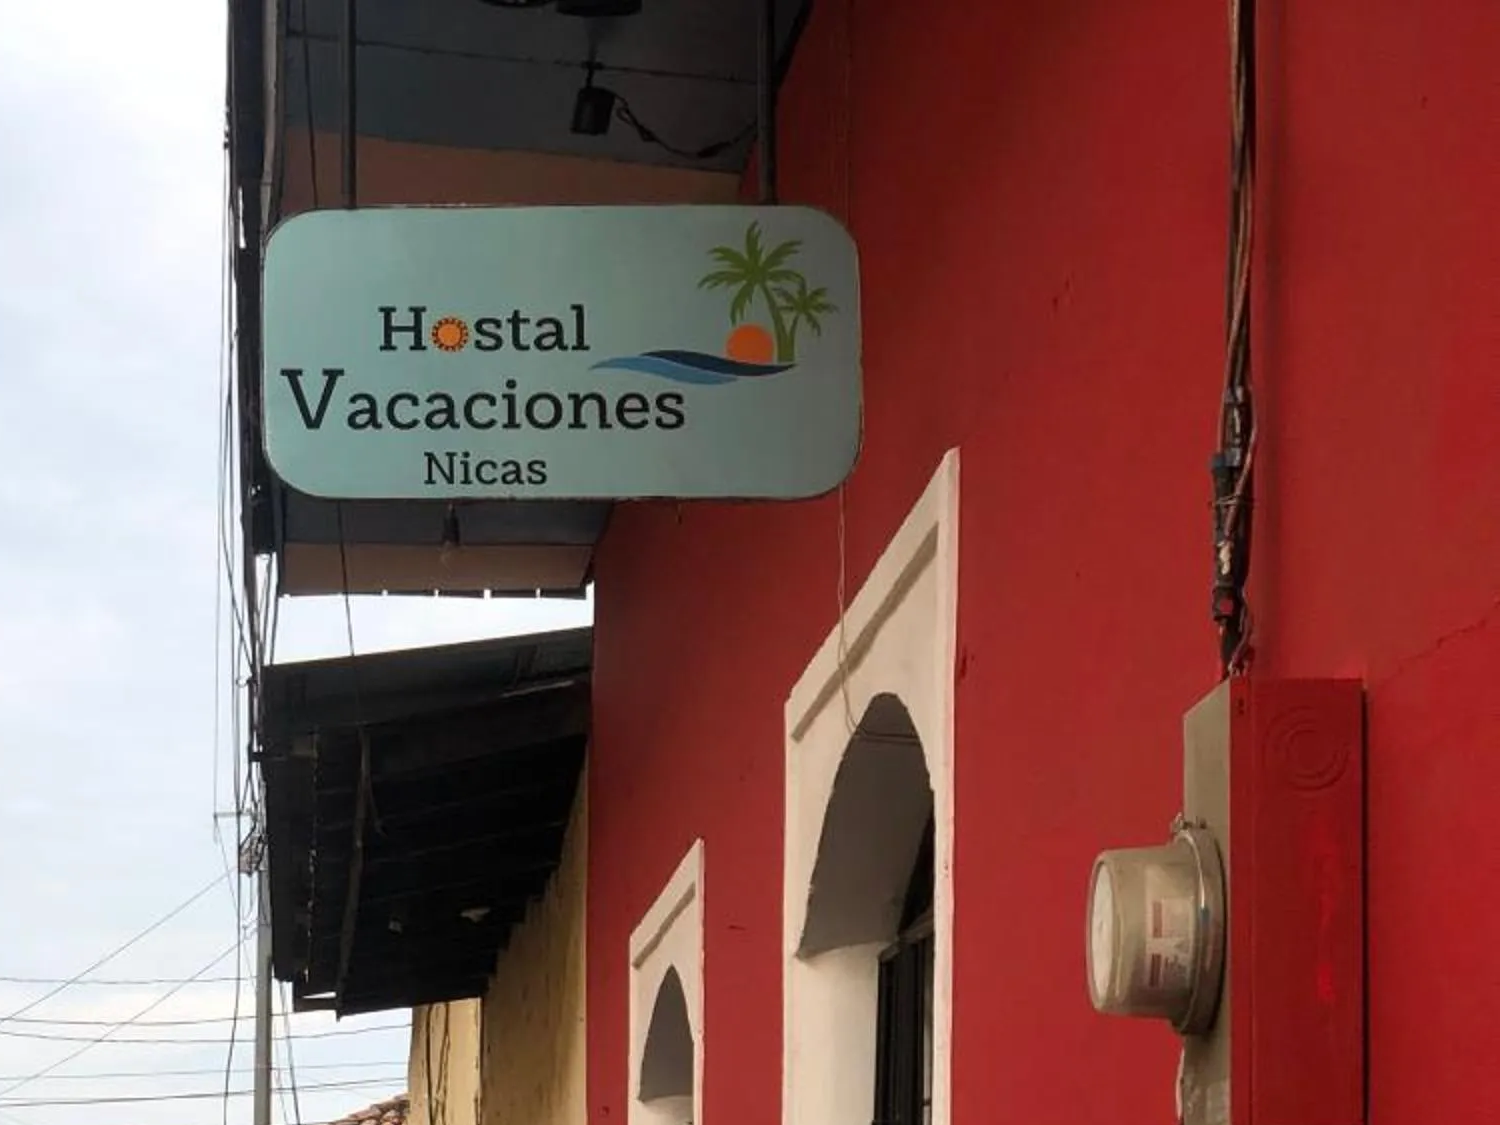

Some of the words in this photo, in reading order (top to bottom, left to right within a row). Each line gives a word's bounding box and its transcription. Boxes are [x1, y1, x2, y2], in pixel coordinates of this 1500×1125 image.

[378, 304, 590, 352] Hostal
[281, 368, 685, 430] Vacaciones
[423, 451, 548, 485] Nicas
